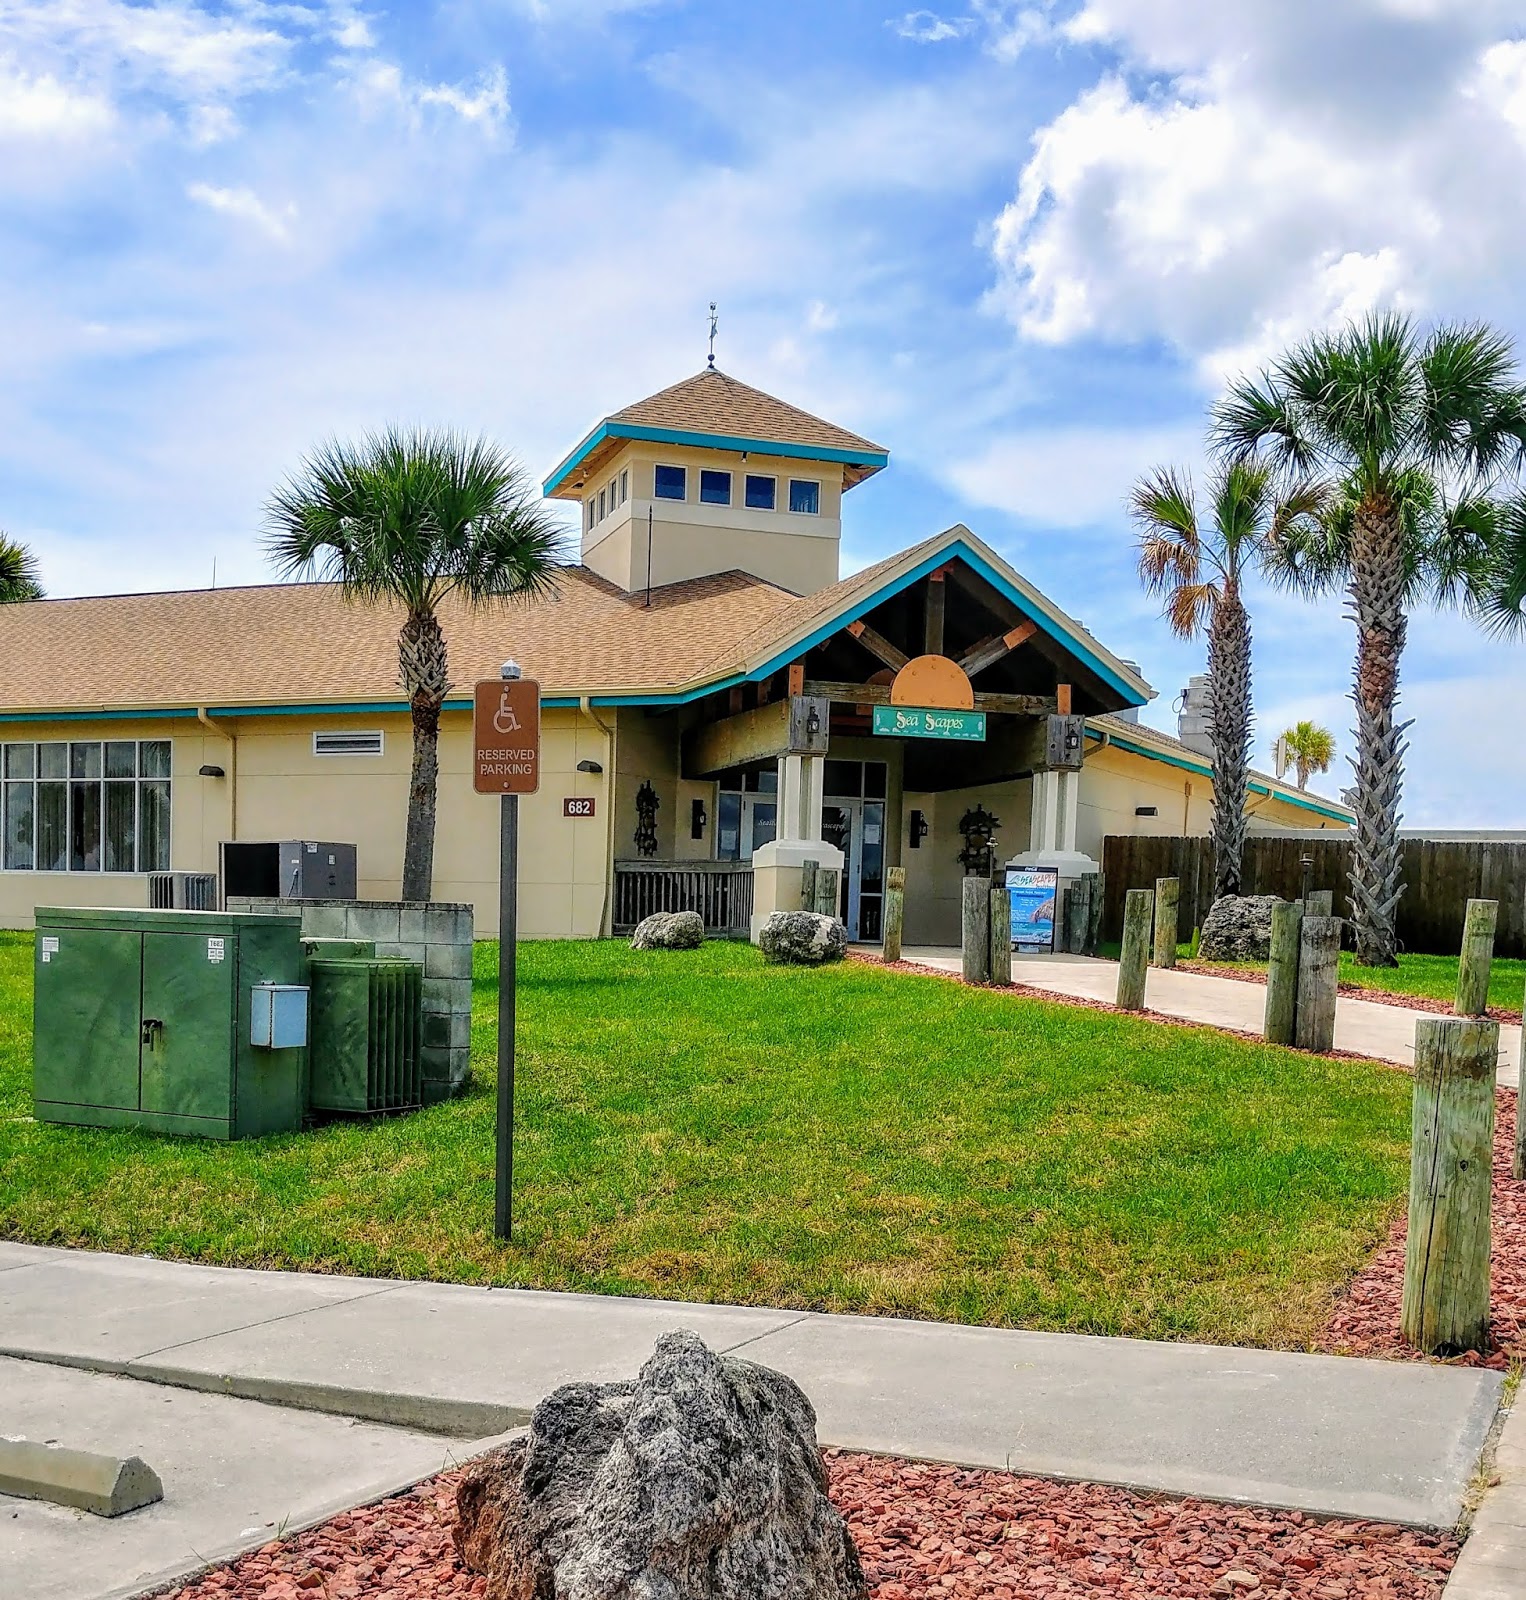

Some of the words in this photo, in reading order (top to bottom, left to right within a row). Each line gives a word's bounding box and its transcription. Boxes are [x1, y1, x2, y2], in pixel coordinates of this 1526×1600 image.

[896, 711, 919, 729] Sea
[925, 713, 964, 732] Scapes
[477, 749, 535, 761] RESERVED
[480, 763, 532, 775] PARKING
[568, 801, 591, 814] 682
